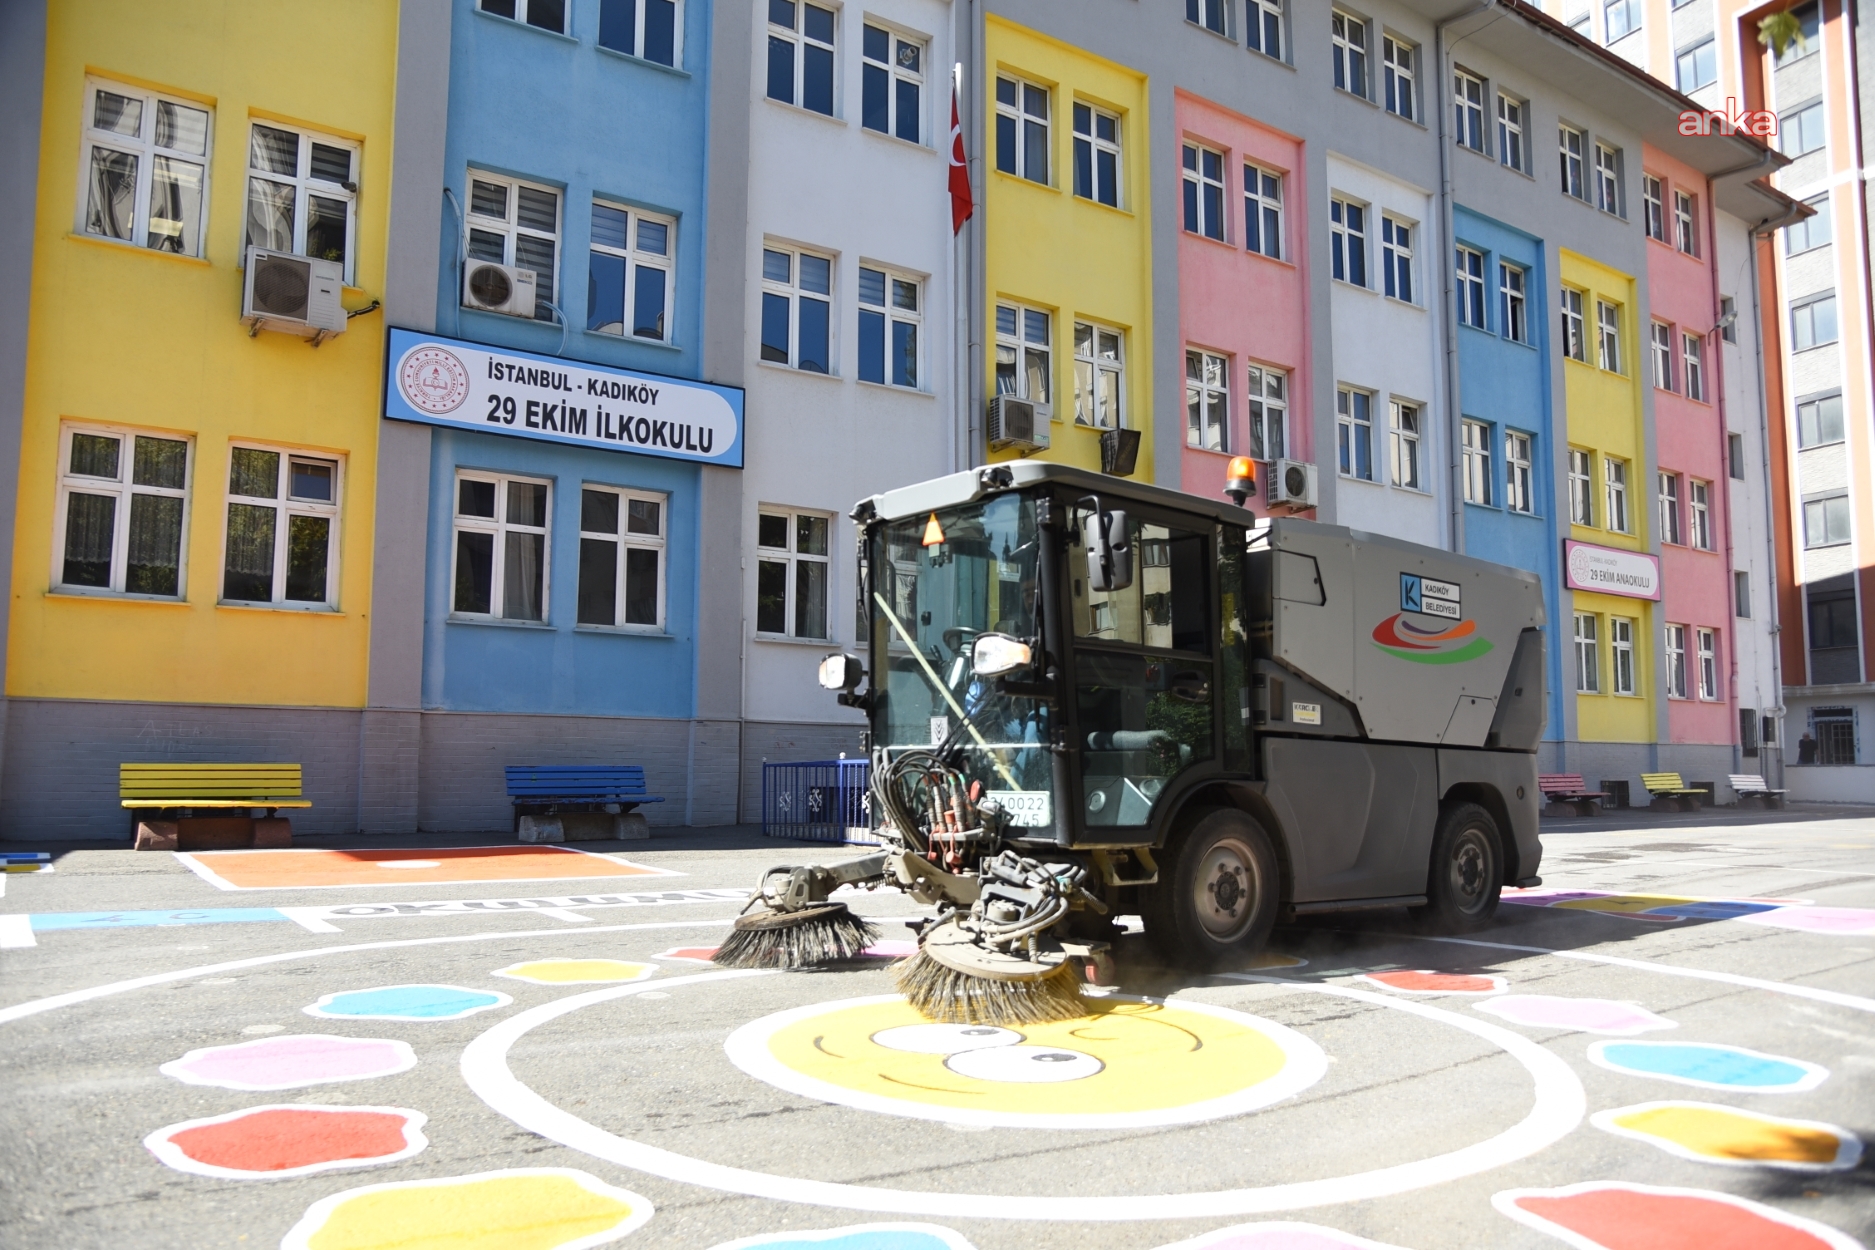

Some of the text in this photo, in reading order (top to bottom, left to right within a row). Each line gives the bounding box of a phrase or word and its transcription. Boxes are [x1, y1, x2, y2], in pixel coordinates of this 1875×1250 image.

[487, 356, 573, 393] İSTANBUL
[587, 377, 660, 406] KADIKÖY
[486, 393, 714, 454] 29 EKİM İLKOKULU
[1590, 568, 1650, 588] 29 EKİM ANAOKULU
[1425, 584, 1449, 595] KADIKÖY
[1426, 602, 1456, 615] BELEDİYESİ
